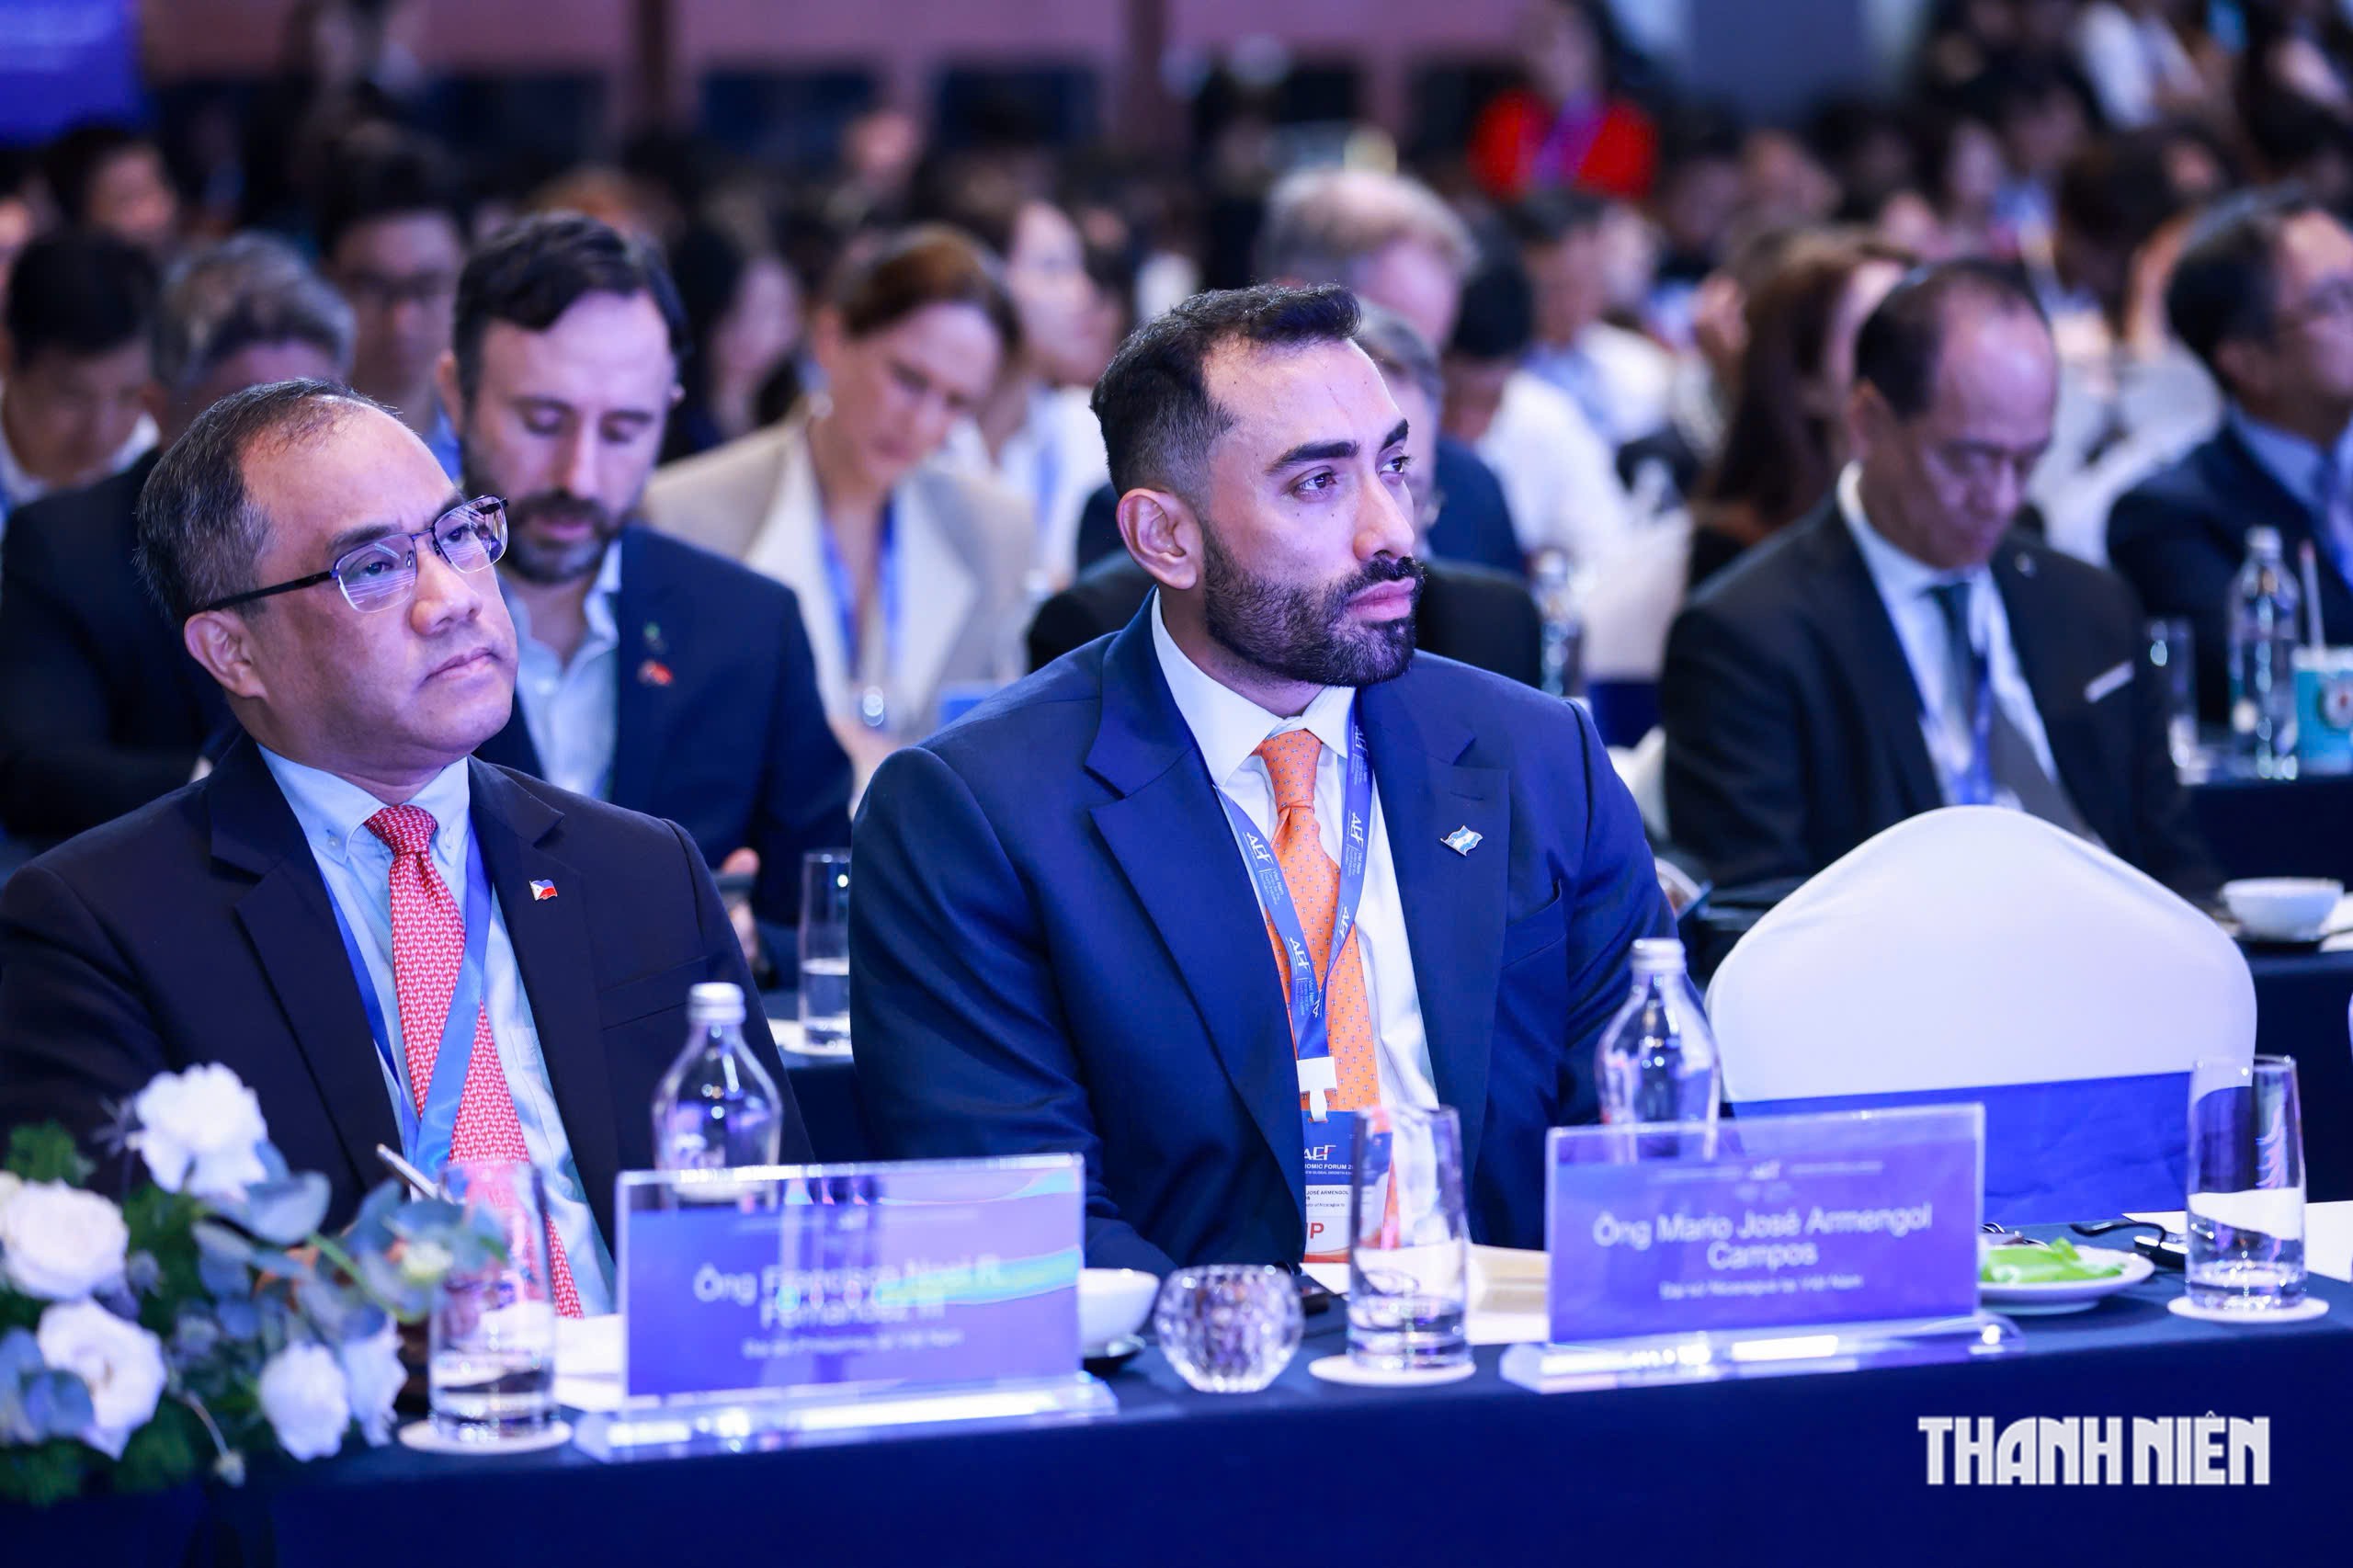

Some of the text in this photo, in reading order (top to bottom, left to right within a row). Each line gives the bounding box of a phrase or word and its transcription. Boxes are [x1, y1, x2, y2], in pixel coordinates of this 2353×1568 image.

[1593, 1201, 1933, 1250] Ông Mario José Armengol
[1707, 1240, 1820, 1272] Campos
[693, 1263, 757, 1307] Ông
